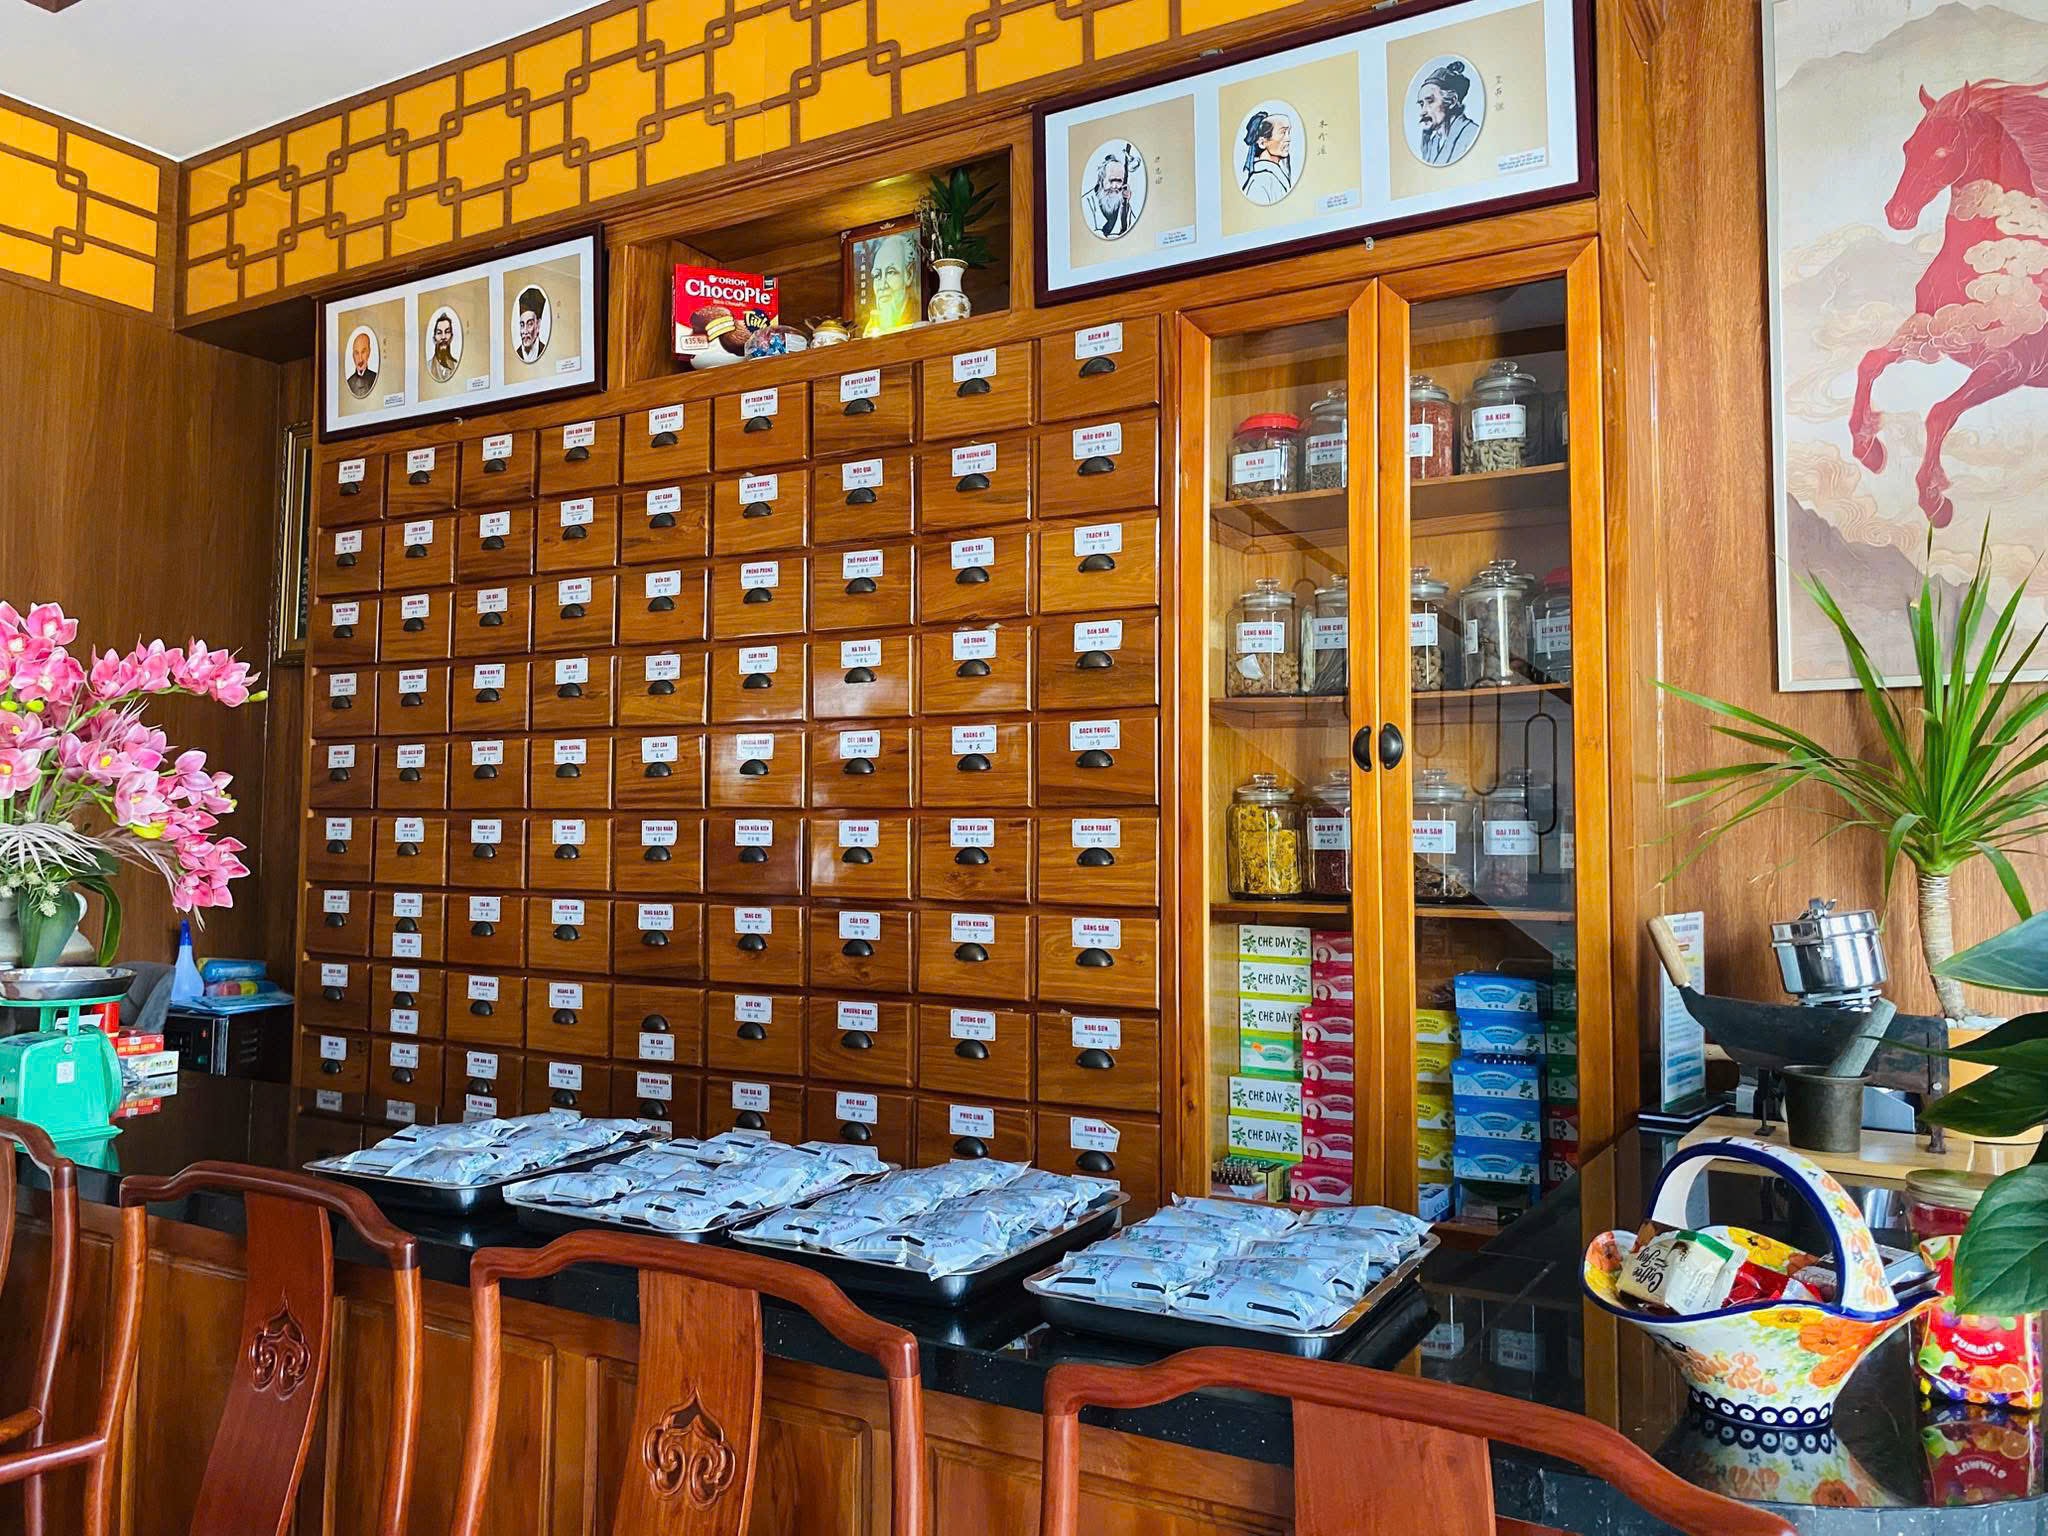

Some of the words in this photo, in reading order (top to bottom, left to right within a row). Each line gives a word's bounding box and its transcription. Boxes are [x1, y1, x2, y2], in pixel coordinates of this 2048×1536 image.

[685, 278, 771, 305] ChocoPie
[718, 277, 747, 286] ORION
[1632, 1265, 1664, 1293] Coffee
